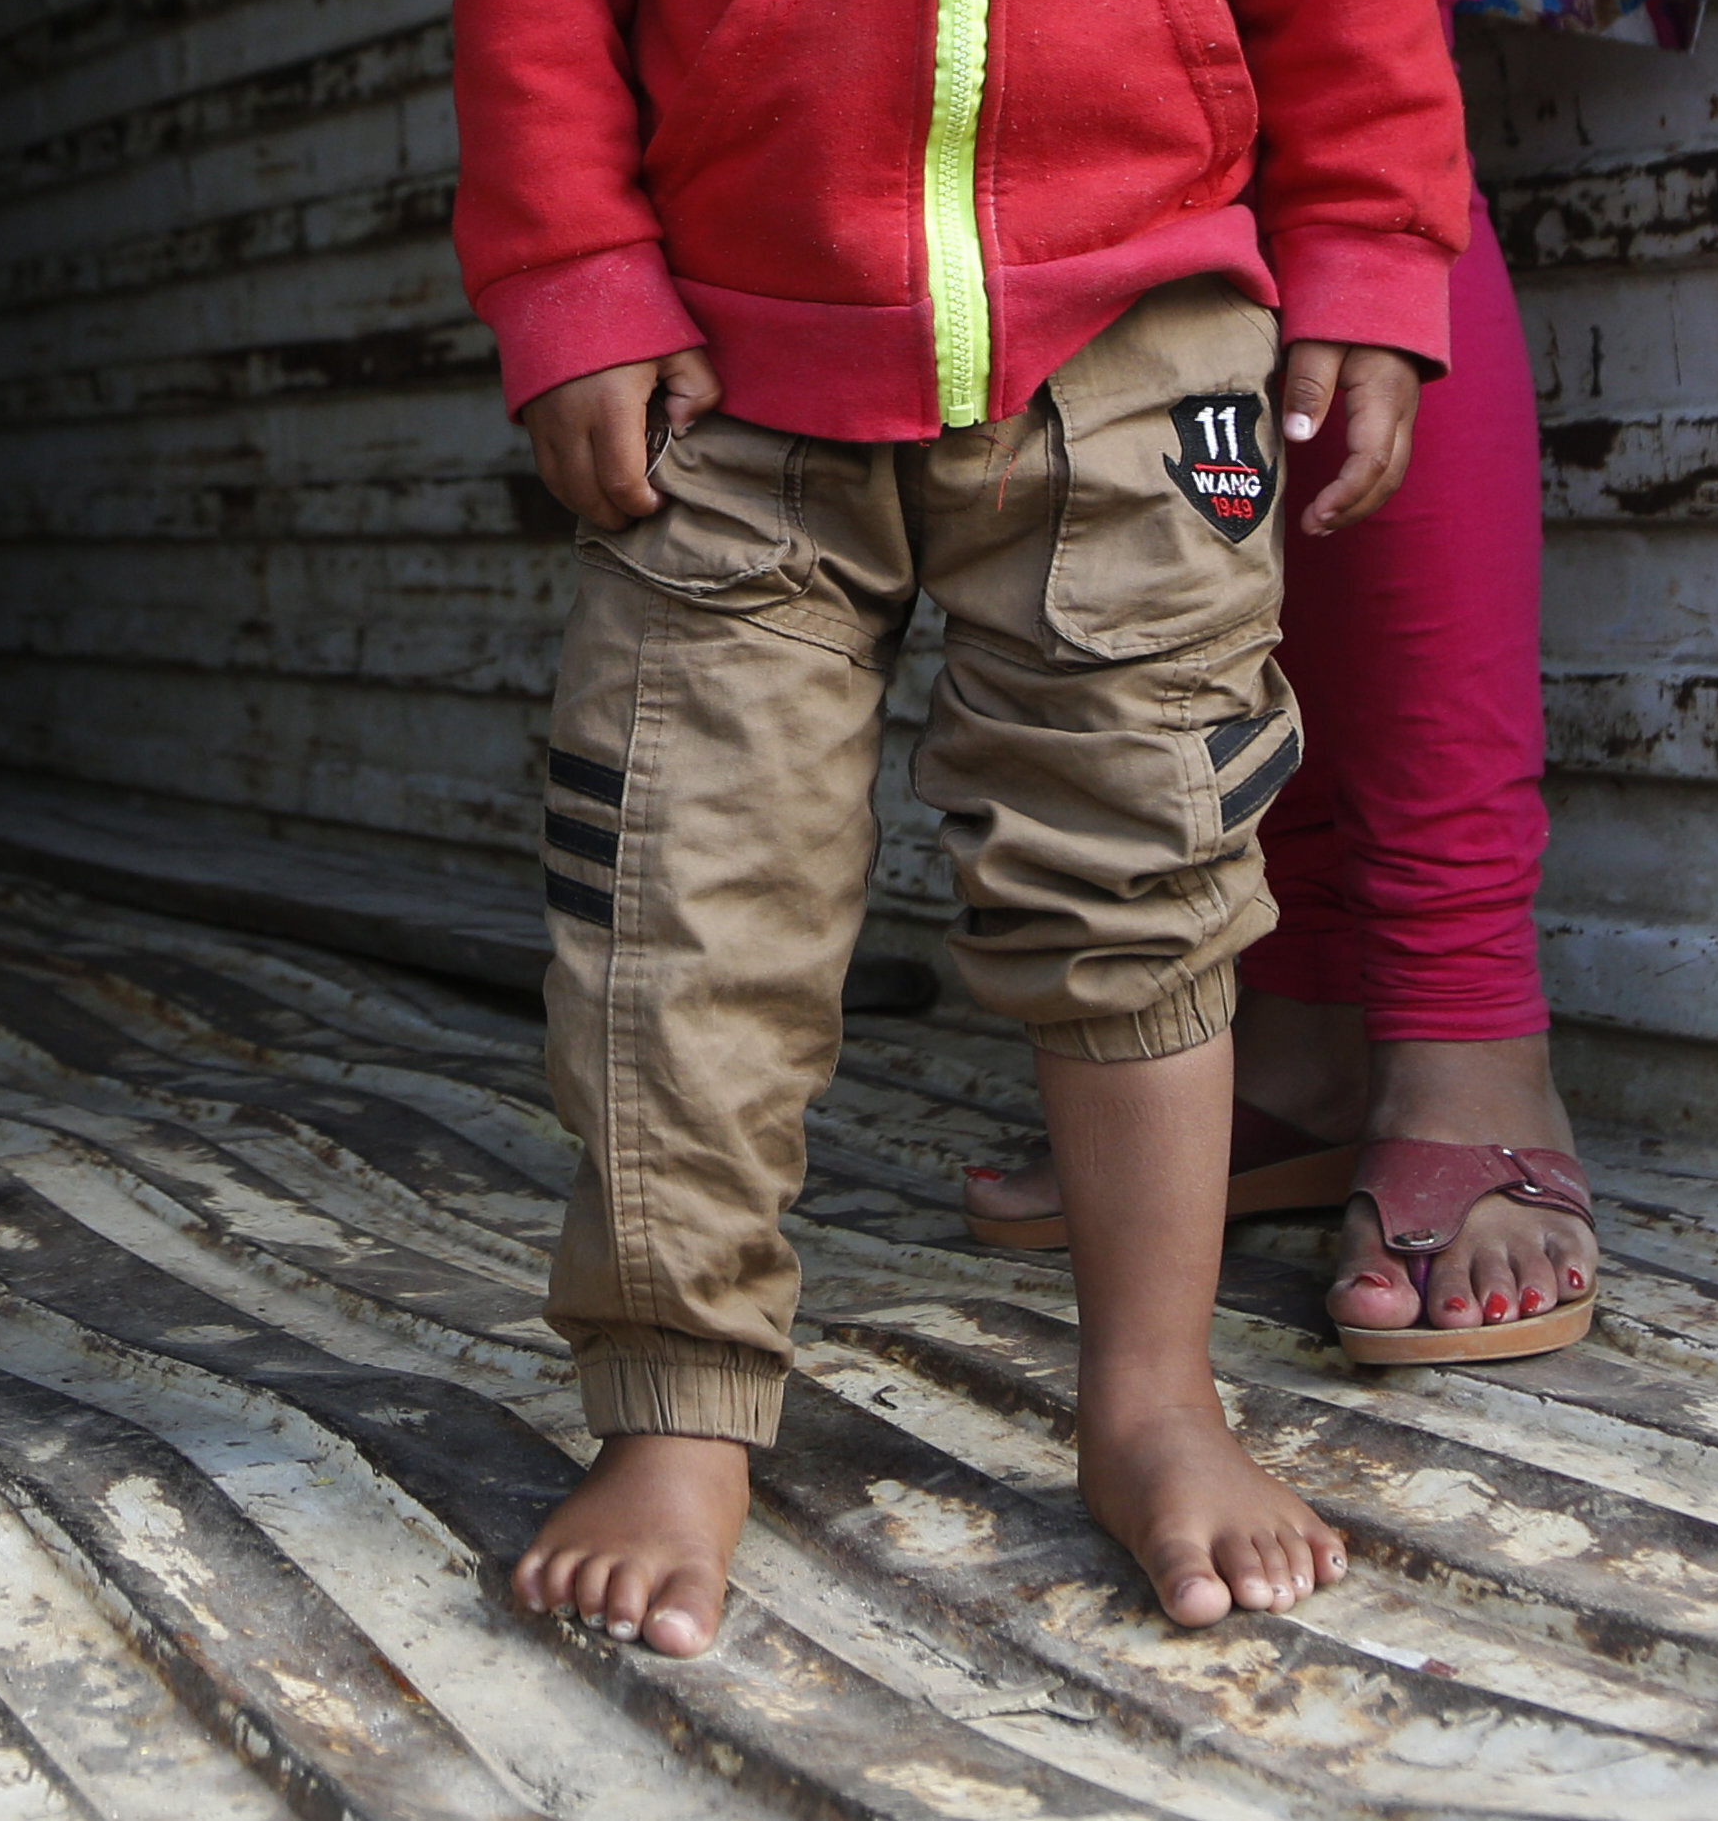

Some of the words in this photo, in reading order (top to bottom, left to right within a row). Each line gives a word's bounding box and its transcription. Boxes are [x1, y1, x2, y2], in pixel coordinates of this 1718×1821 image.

[1194, 406, 1238, 461] 11
[1191, 471, 1262, 497] WANG
[1211, 497, 1255, 519] 1949
